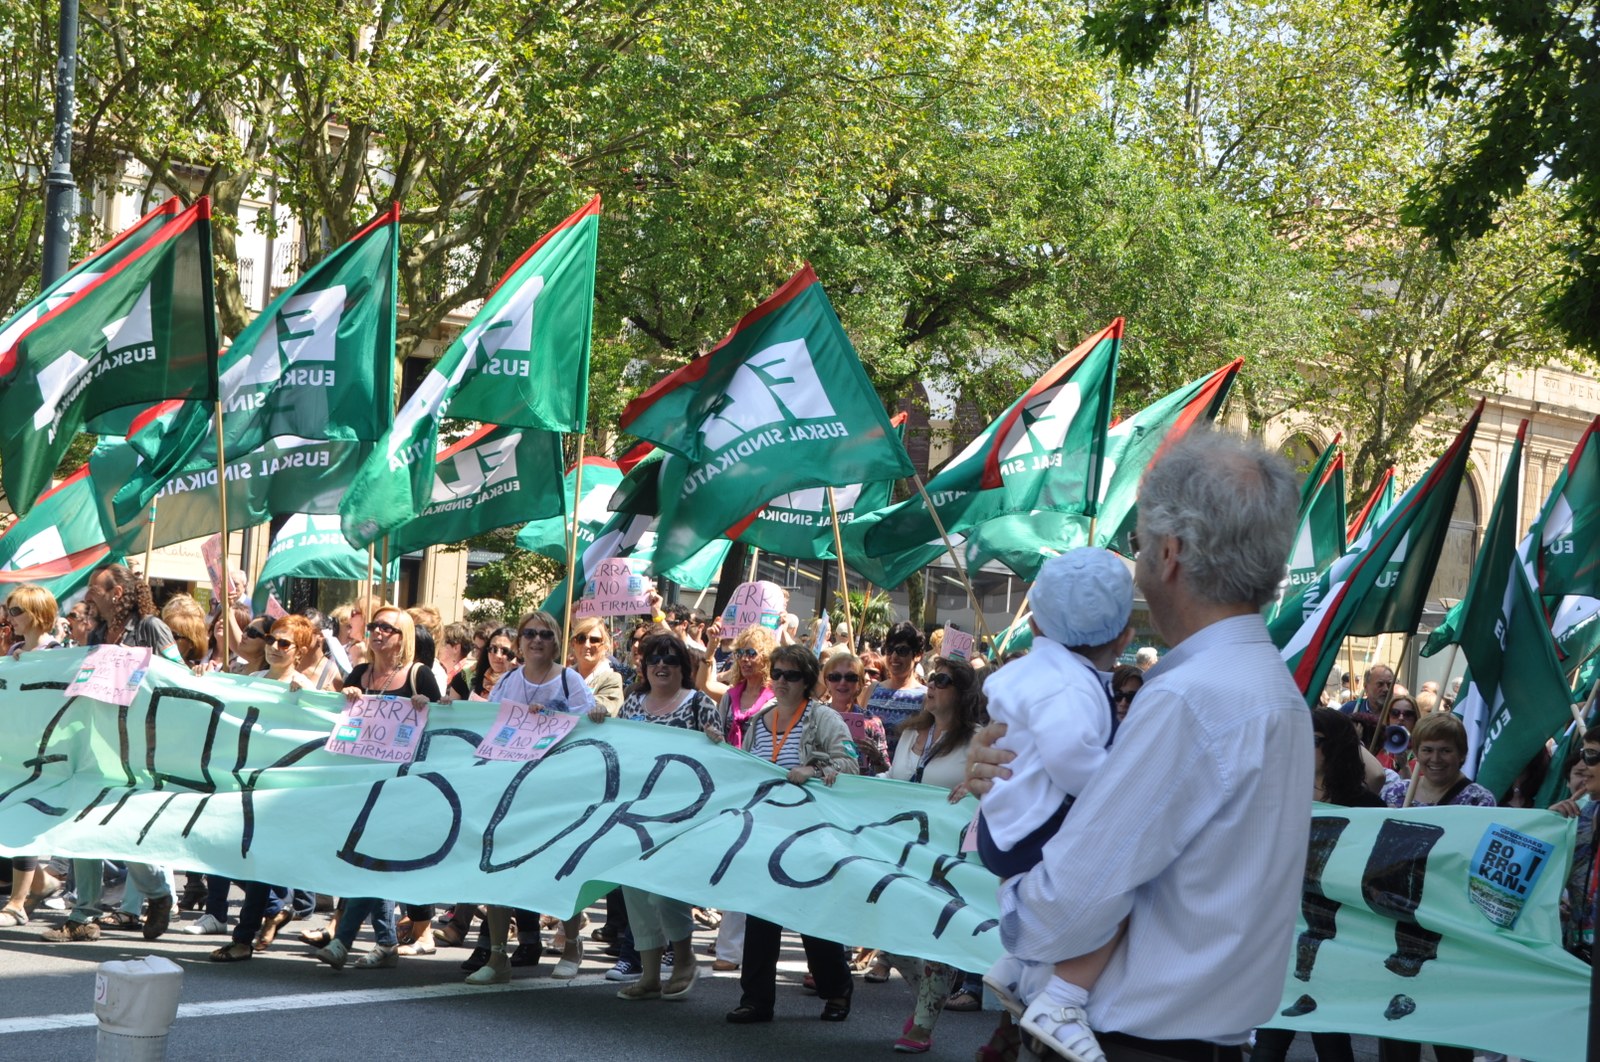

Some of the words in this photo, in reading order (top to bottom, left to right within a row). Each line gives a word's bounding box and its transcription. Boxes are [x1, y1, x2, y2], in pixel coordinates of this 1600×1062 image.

[597, 581, 620, 595] NO
[580, 602, 595, 612] HA
[739, 611, 757, 624] NO
[348, 698, 419, 727] BERRA
[506, 705, 571, 735] BERRA
[361, 724, 387, 741] NO
[511, 736, 532, 748] NO
[329, 741, 347, 754] HA
[350, 742, 413, 762] FIRMADO
[478, 745, 493, 757] HA
[1488, 839, 1515, 860] BO
[1482, 851, 1522, 877] RRO
